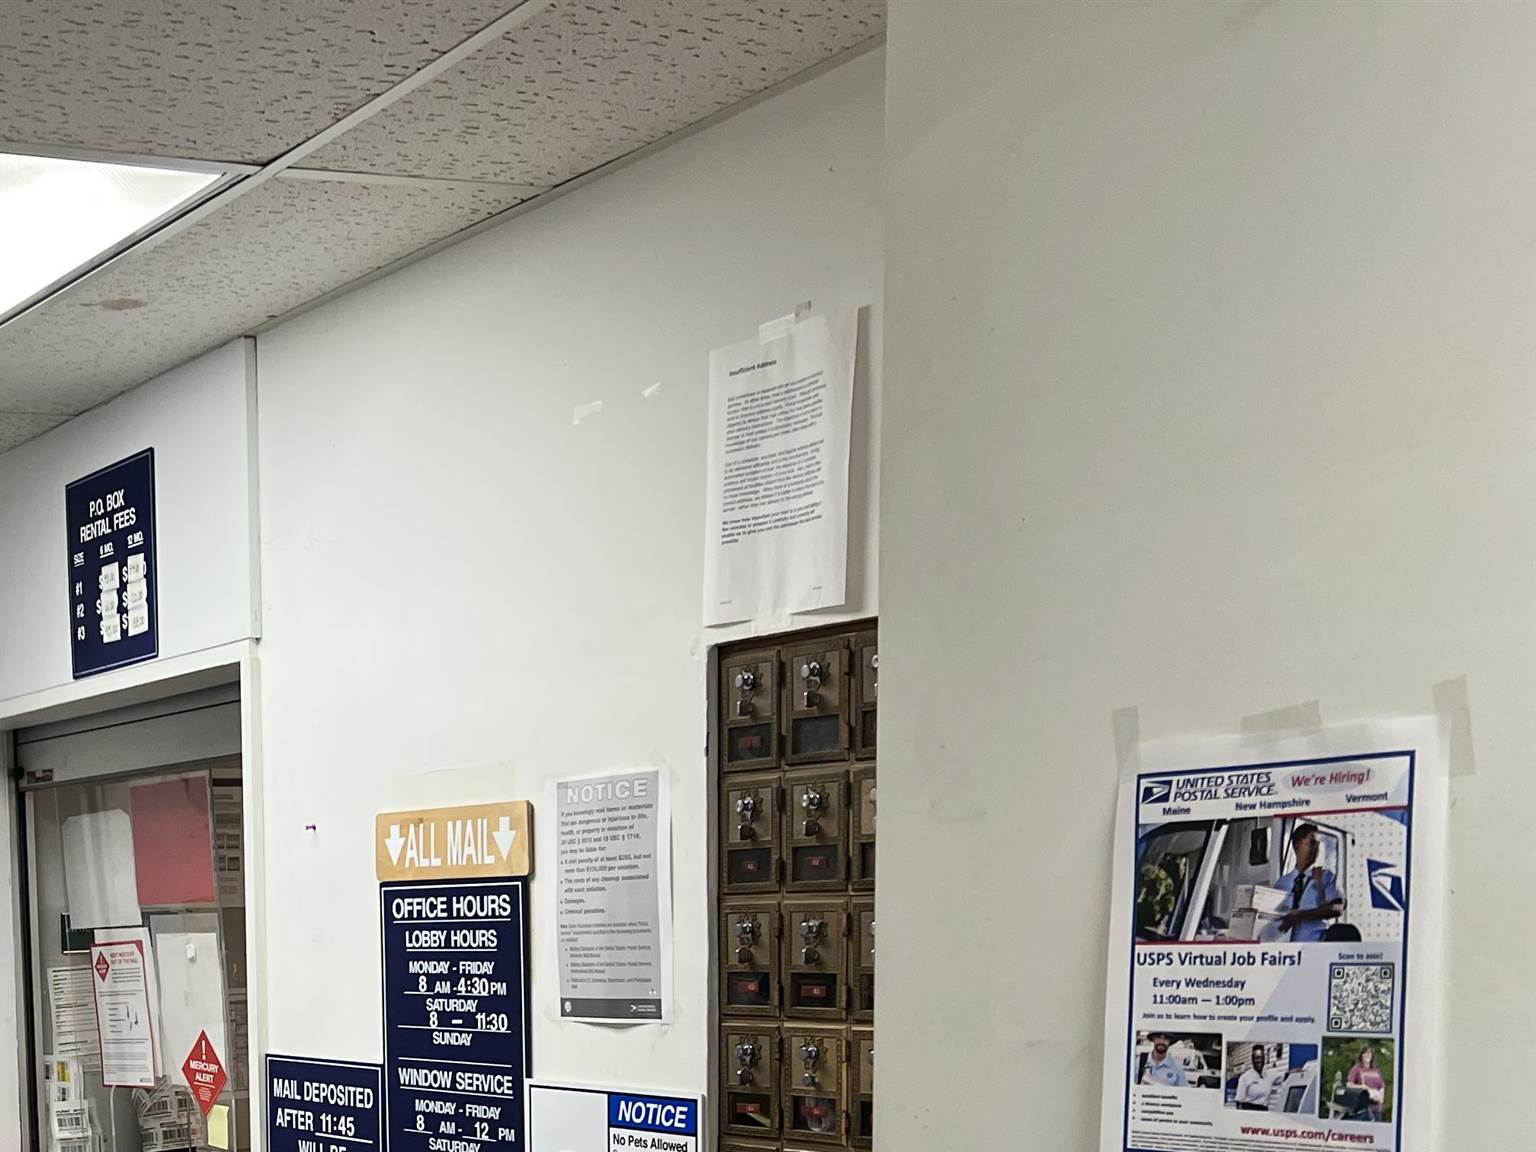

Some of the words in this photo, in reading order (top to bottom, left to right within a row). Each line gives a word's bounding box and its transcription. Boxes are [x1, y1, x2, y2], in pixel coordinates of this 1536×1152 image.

[106, 489, 125, 511] BOX
[80, 517, 112, 543] RENTAL
[113, 508, 136, 531] FEES
[1176, 777, 1225, 789] UNITED
[1227, 772, 1272, 785] STATES
[1291, 775, 1327, 787] We're
[1329, 769, 1371, 785] Hiring!
[567, 778, 648, 804] NOTICE
[1174, 787, 1221, 802] POSTAL
[1163, 807, 1191, 815] Maine
[1235, 803, 1256, 811] New
[1259, 798, 1311, 810] Hampshire
[1346, 792, 1388, 803] Vermont
[405, 822, 441, 868] ALL
[447, 817, 495, 865] MAIL
[392, 897, 448, 918] OFFICE
[453, 895, 510, 917] HOURS
[406, 930, 446, 947] LOBBY
[451, 930, 497, 947] HOURS
[409, 961, 450, 973] MONDAY
[459, 961, 494, 974] FRIDAY
[1137, 953, 1173, 966] USPS
[1178, 952, 1226, 966] Virtual
[1230, 952, 1256, 965] Job
[1261, 951, 1301, 965] Fairs!
[418, 976, 427, 992] 8
[434, 981, 450, 994] AM
[457, 977, 489, 995] 4:30
[490, 982, 506, 995] PM
[1153, 978, 1181, 988] Every
[1184, 978, 1246, 990] Wednesday
[426, 998, 478, 1012] SATURDAY
[1153, 994, 1198, 1005] 11:00am
[1215, 996, 1255, 1007] 1:00pm
[429, 1012, 437, 1028] 8
[475, 1014, 508, 1031] 11:30
[433, 1032, 472, 1046] SUNDAY
[190, 1060, 219, 1072] MERCURY
[195, 1072, 214, 1083] ALERT
[398, 1068, 452, 1088] WINDOW
[455, 1072, 513, 1094] SERVICE
[273, 1078, 301, 1100] MAIL
[304, 1082, 373, 1109] DEPOSITED
[415, 1099, 456, 1115] MONDAY
[466, 1104, 501, 1119] FRIDAY
[618, 1101, 688, 1128] NOTICE
[276, 1107, 313, 1131] AFTER
[320, 1112, 355, 1136] 11:45
[416, 1115, 425, 1130] 8
[439, 1121, 455, 1134] AM
[474, 1121, 489, 1139] 12
[498, 1128, 515, 1141] PM
[613, 1134, 625, 1145] No
[628, 1135, 648, 1148] Pets
[651, 1138, 688, 1152] Allowed
[1240, 1125, 1375, 1144] www.usps.com/careers
